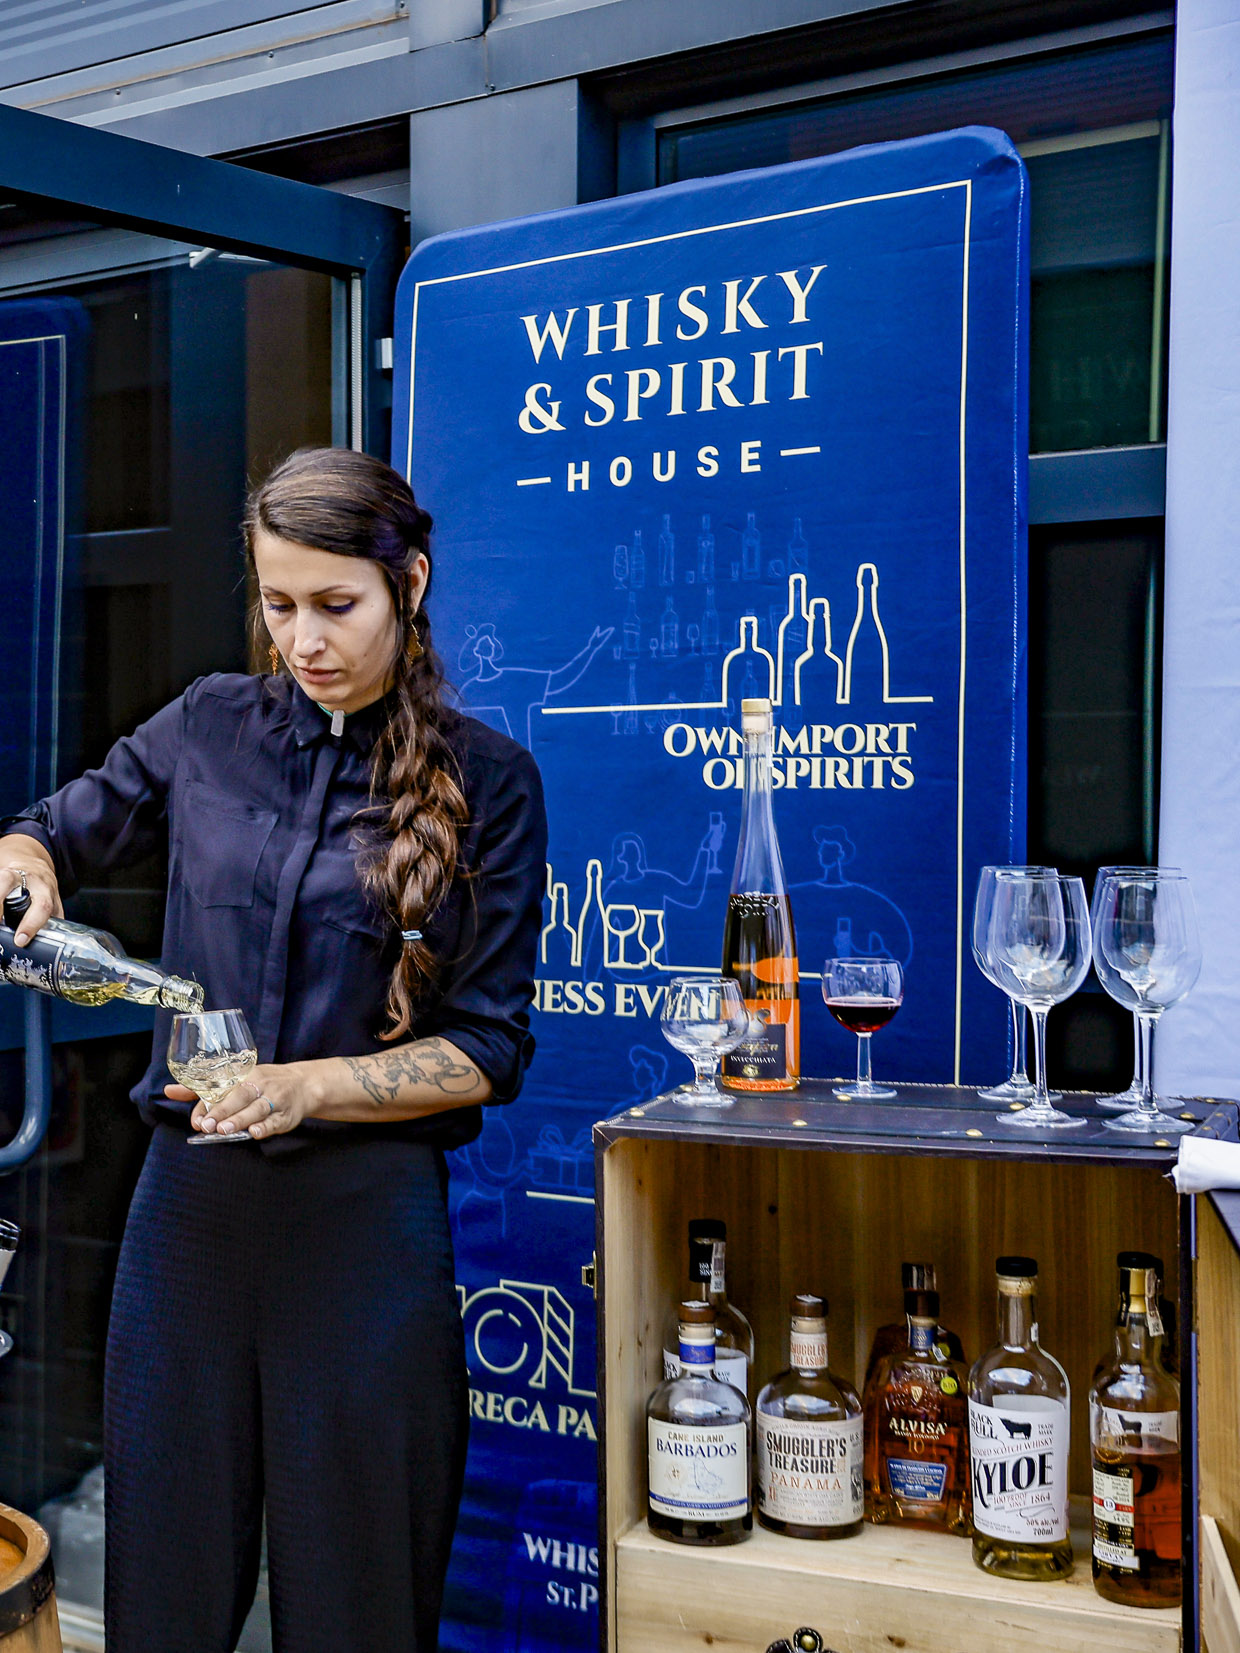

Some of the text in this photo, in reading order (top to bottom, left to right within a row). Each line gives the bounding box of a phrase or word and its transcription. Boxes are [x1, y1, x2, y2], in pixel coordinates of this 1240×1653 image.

[520, 264, 828, 364] WHISKY
[518, 341, 824, 434] & SPIRIT
[567, 440, 762, 493] HOUSE
[771, 756, 915, 790] SPIRITS
[668, 1431, 724, 1443] CANE ISLAND
[889, 1416, 946, 1436] ALVISA
[656, 1437, 737, 1458] BARBADOS
[766, 1430, 847, 1458] SMUGGLER'S
[1025, 1438, 1054, 1450] WHISKY
[768, 1450, 836, 1474] TREASURE
[770, 1471, 841, 1490] PANAMA
